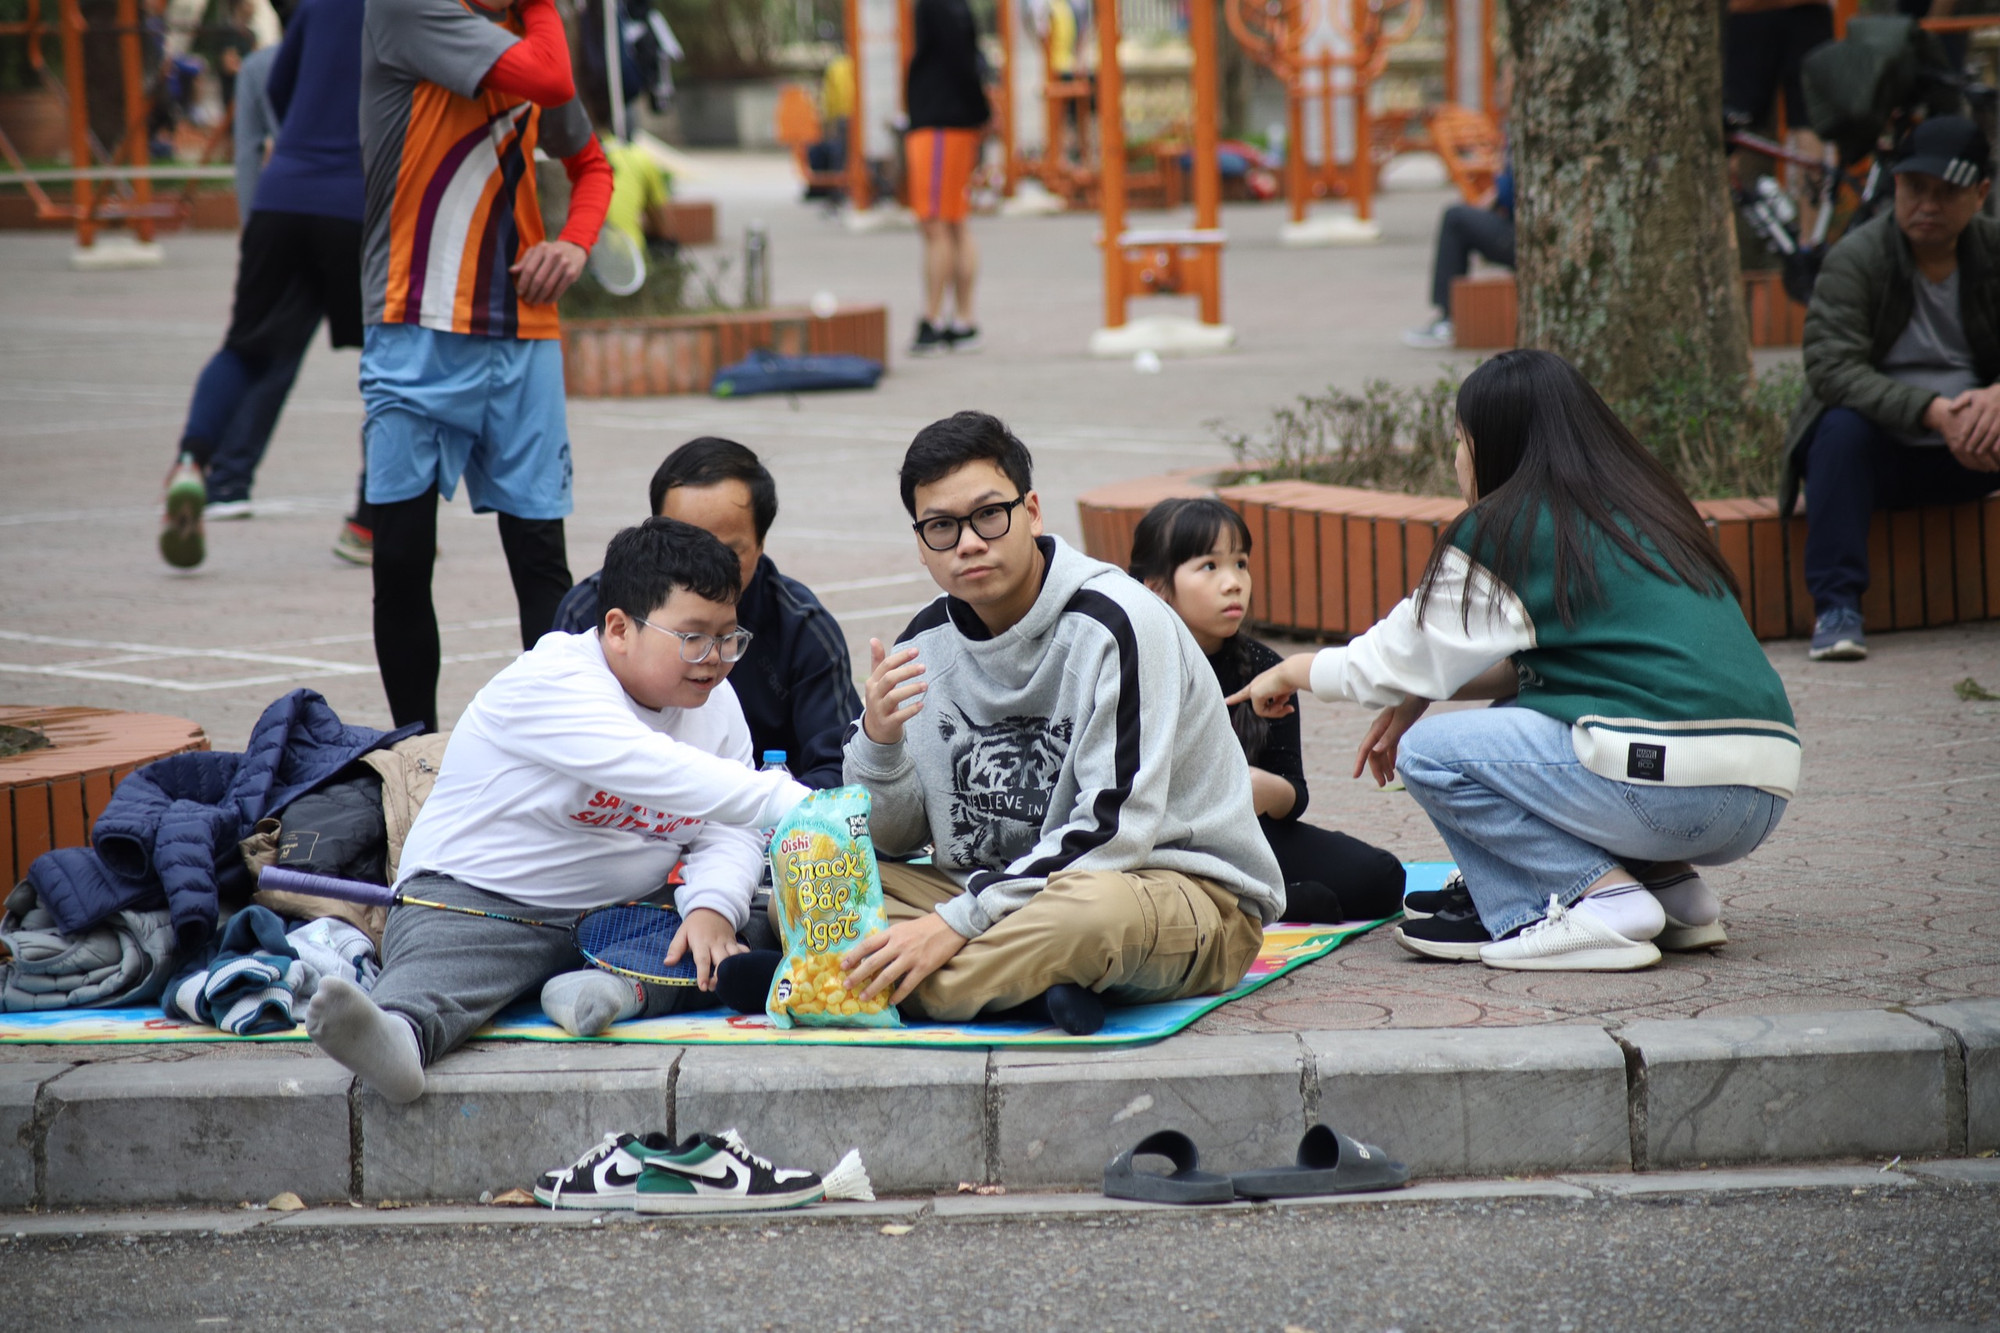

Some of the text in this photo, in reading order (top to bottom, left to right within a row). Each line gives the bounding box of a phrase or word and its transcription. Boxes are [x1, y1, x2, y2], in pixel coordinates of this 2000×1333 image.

[966, 793, 1024, 811] BELIEVE
[1027, 804, 1043, 816] IN
[781, 836, 810, 854] Oishi
[786, 852, 864, 886] Snack
[798, 881, 849, 912] Bắp
